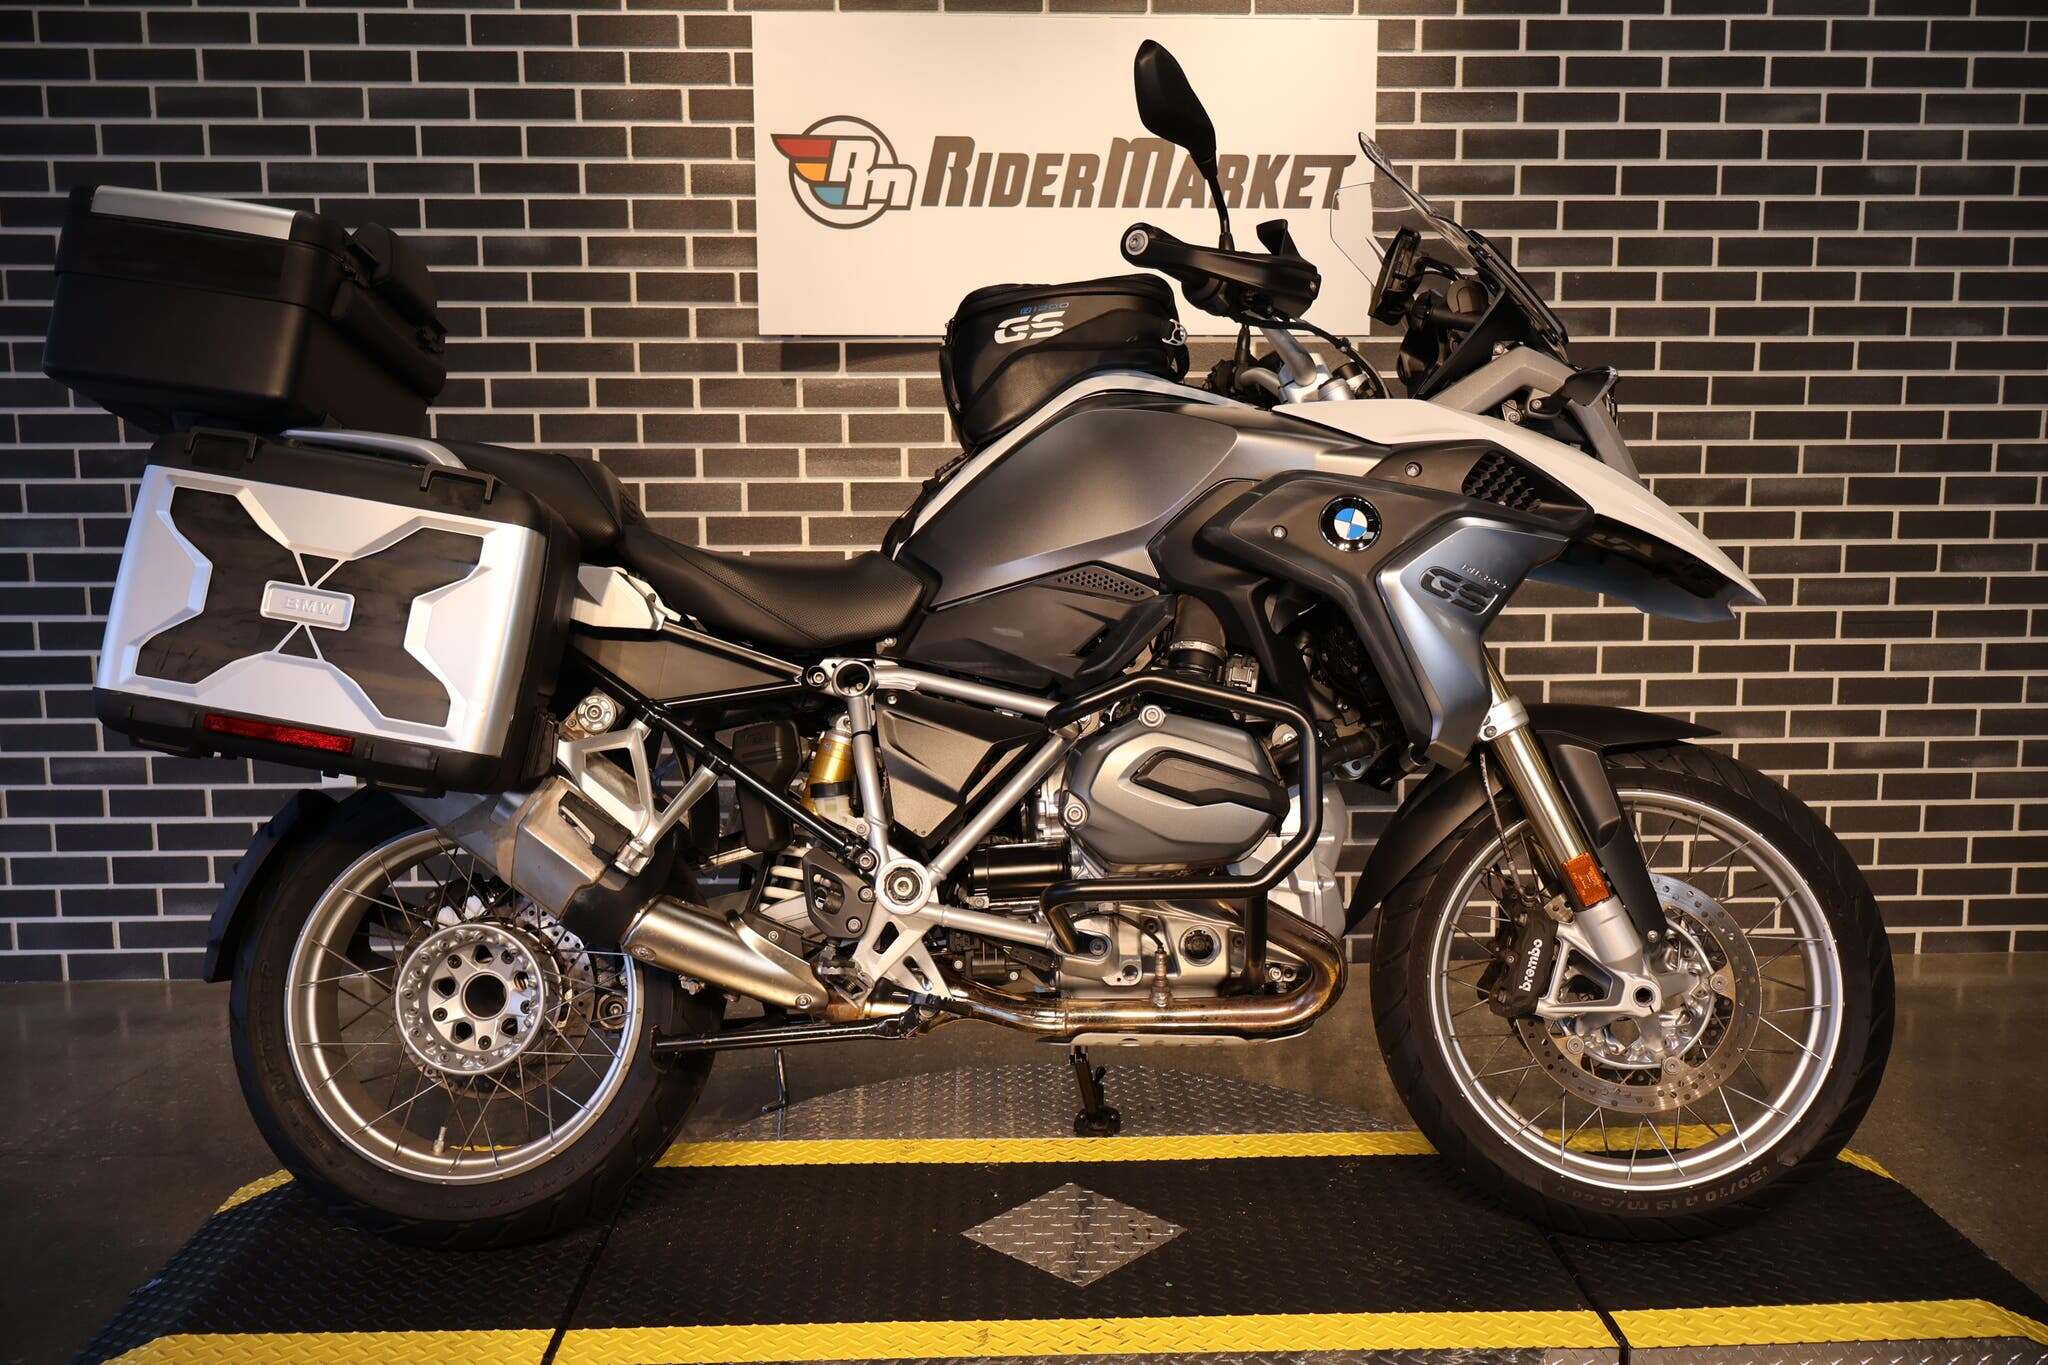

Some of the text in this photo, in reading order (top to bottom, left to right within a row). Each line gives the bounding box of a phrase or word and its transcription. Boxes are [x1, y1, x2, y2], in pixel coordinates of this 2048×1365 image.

[994, 310, 1066, 344] GS
[286, 598, 336, 616] BMW
[1419, 566, 1498, 615] GS
[1519, 938, 1543, 992] brembo
